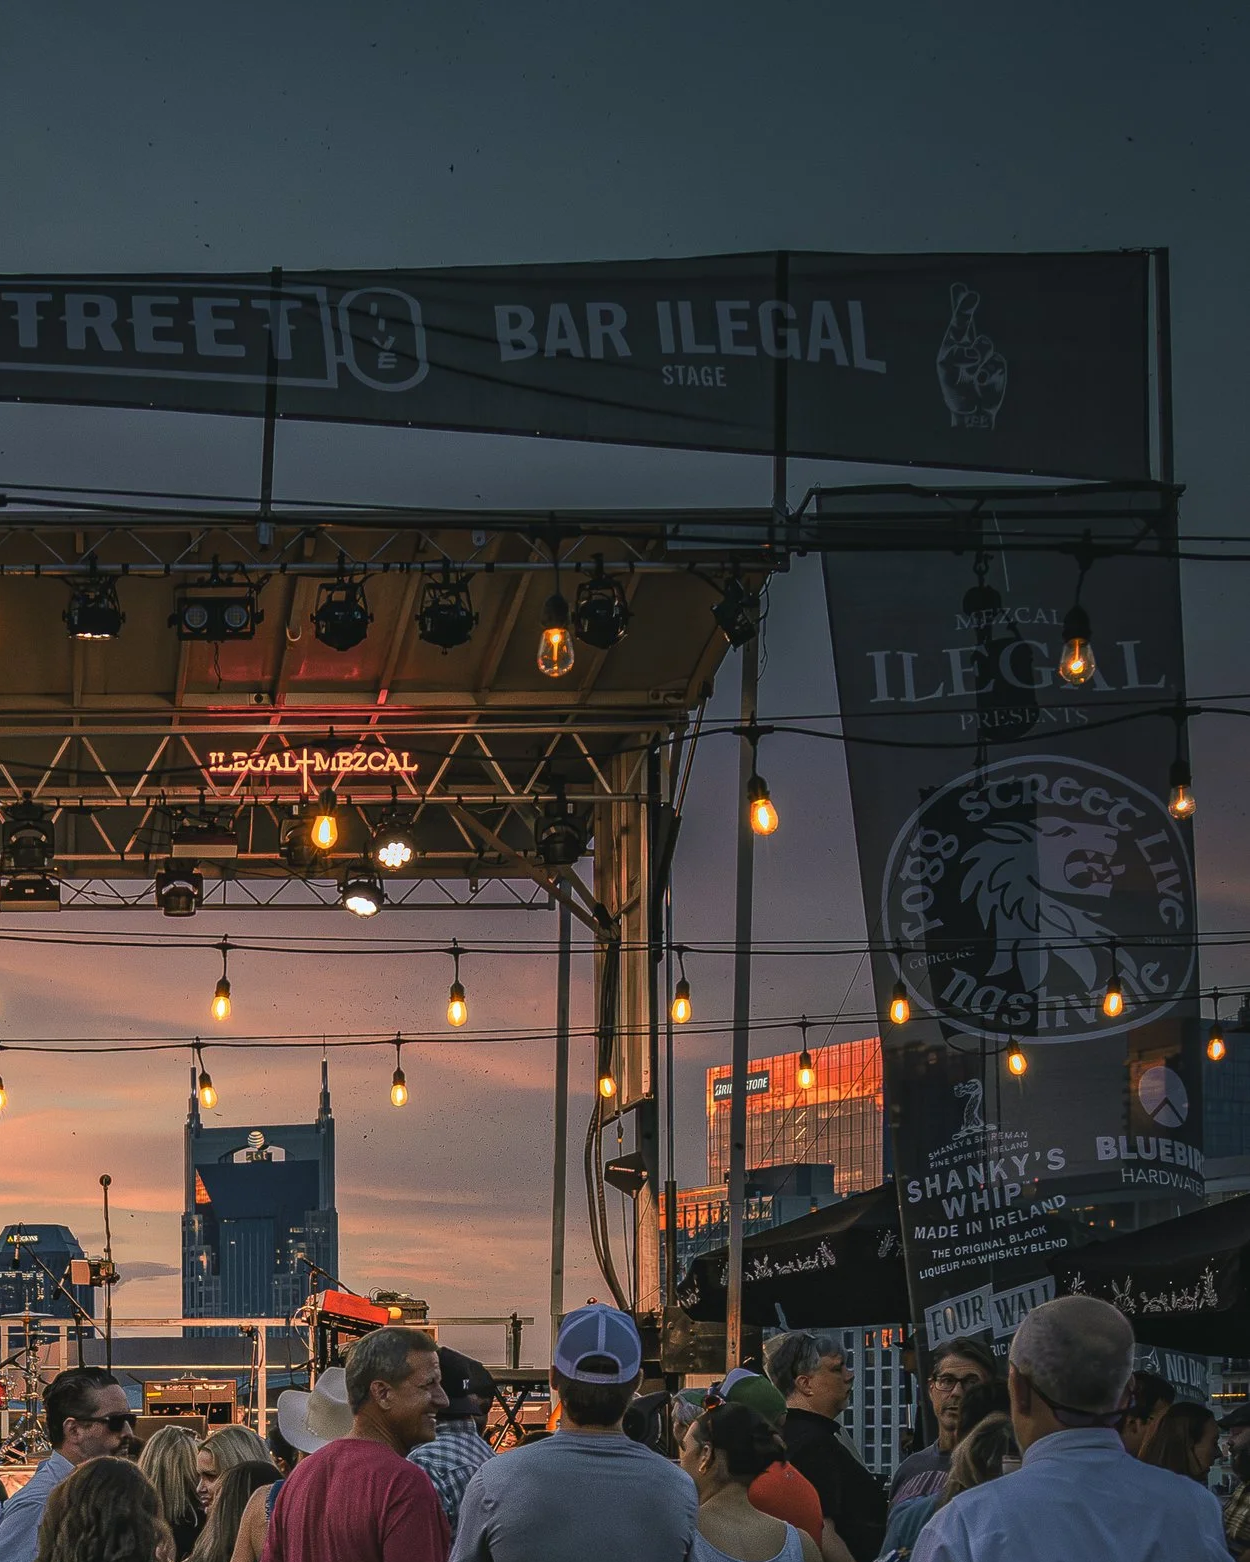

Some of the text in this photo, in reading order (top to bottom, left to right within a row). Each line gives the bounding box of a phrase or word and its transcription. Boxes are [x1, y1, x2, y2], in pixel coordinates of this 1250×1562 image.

[494, 299, 887, 375] BAR ILEGAL
[661, 364, 728, 388] STAGE
[953, 607, 1064, 631] MEZCAL
[959, 706, 1089, 732] PRESENTS
[208, 751, 418, 773] ILEGAL MEZCAL
[715, 1076, 769, 1096] BRISTONE
[928, 1130, 1029, 1161] SHANKY & SHIREMAN
[929, 1140, 1030, 1169] FINE SPIRITS IRELAND
[1095, 1135, 1207, 1180] BLUEBIR
[907, 1147, 1067, 1205] SHANKY'S
[1121, 1167, 1206, 1199] HARDWATE
[914, 1194, 1068, 1241] MADE IN IRELAND
[941, 1183, 1022, 1222] WHIP
[919, 1238, 1069, 1280] LIQUEUR AND WHISKEY BLEND
[932, 1225, 1048, 1260] THE ORIGINAL BLACK
[930, 1294, 987, 1341] FOUR
